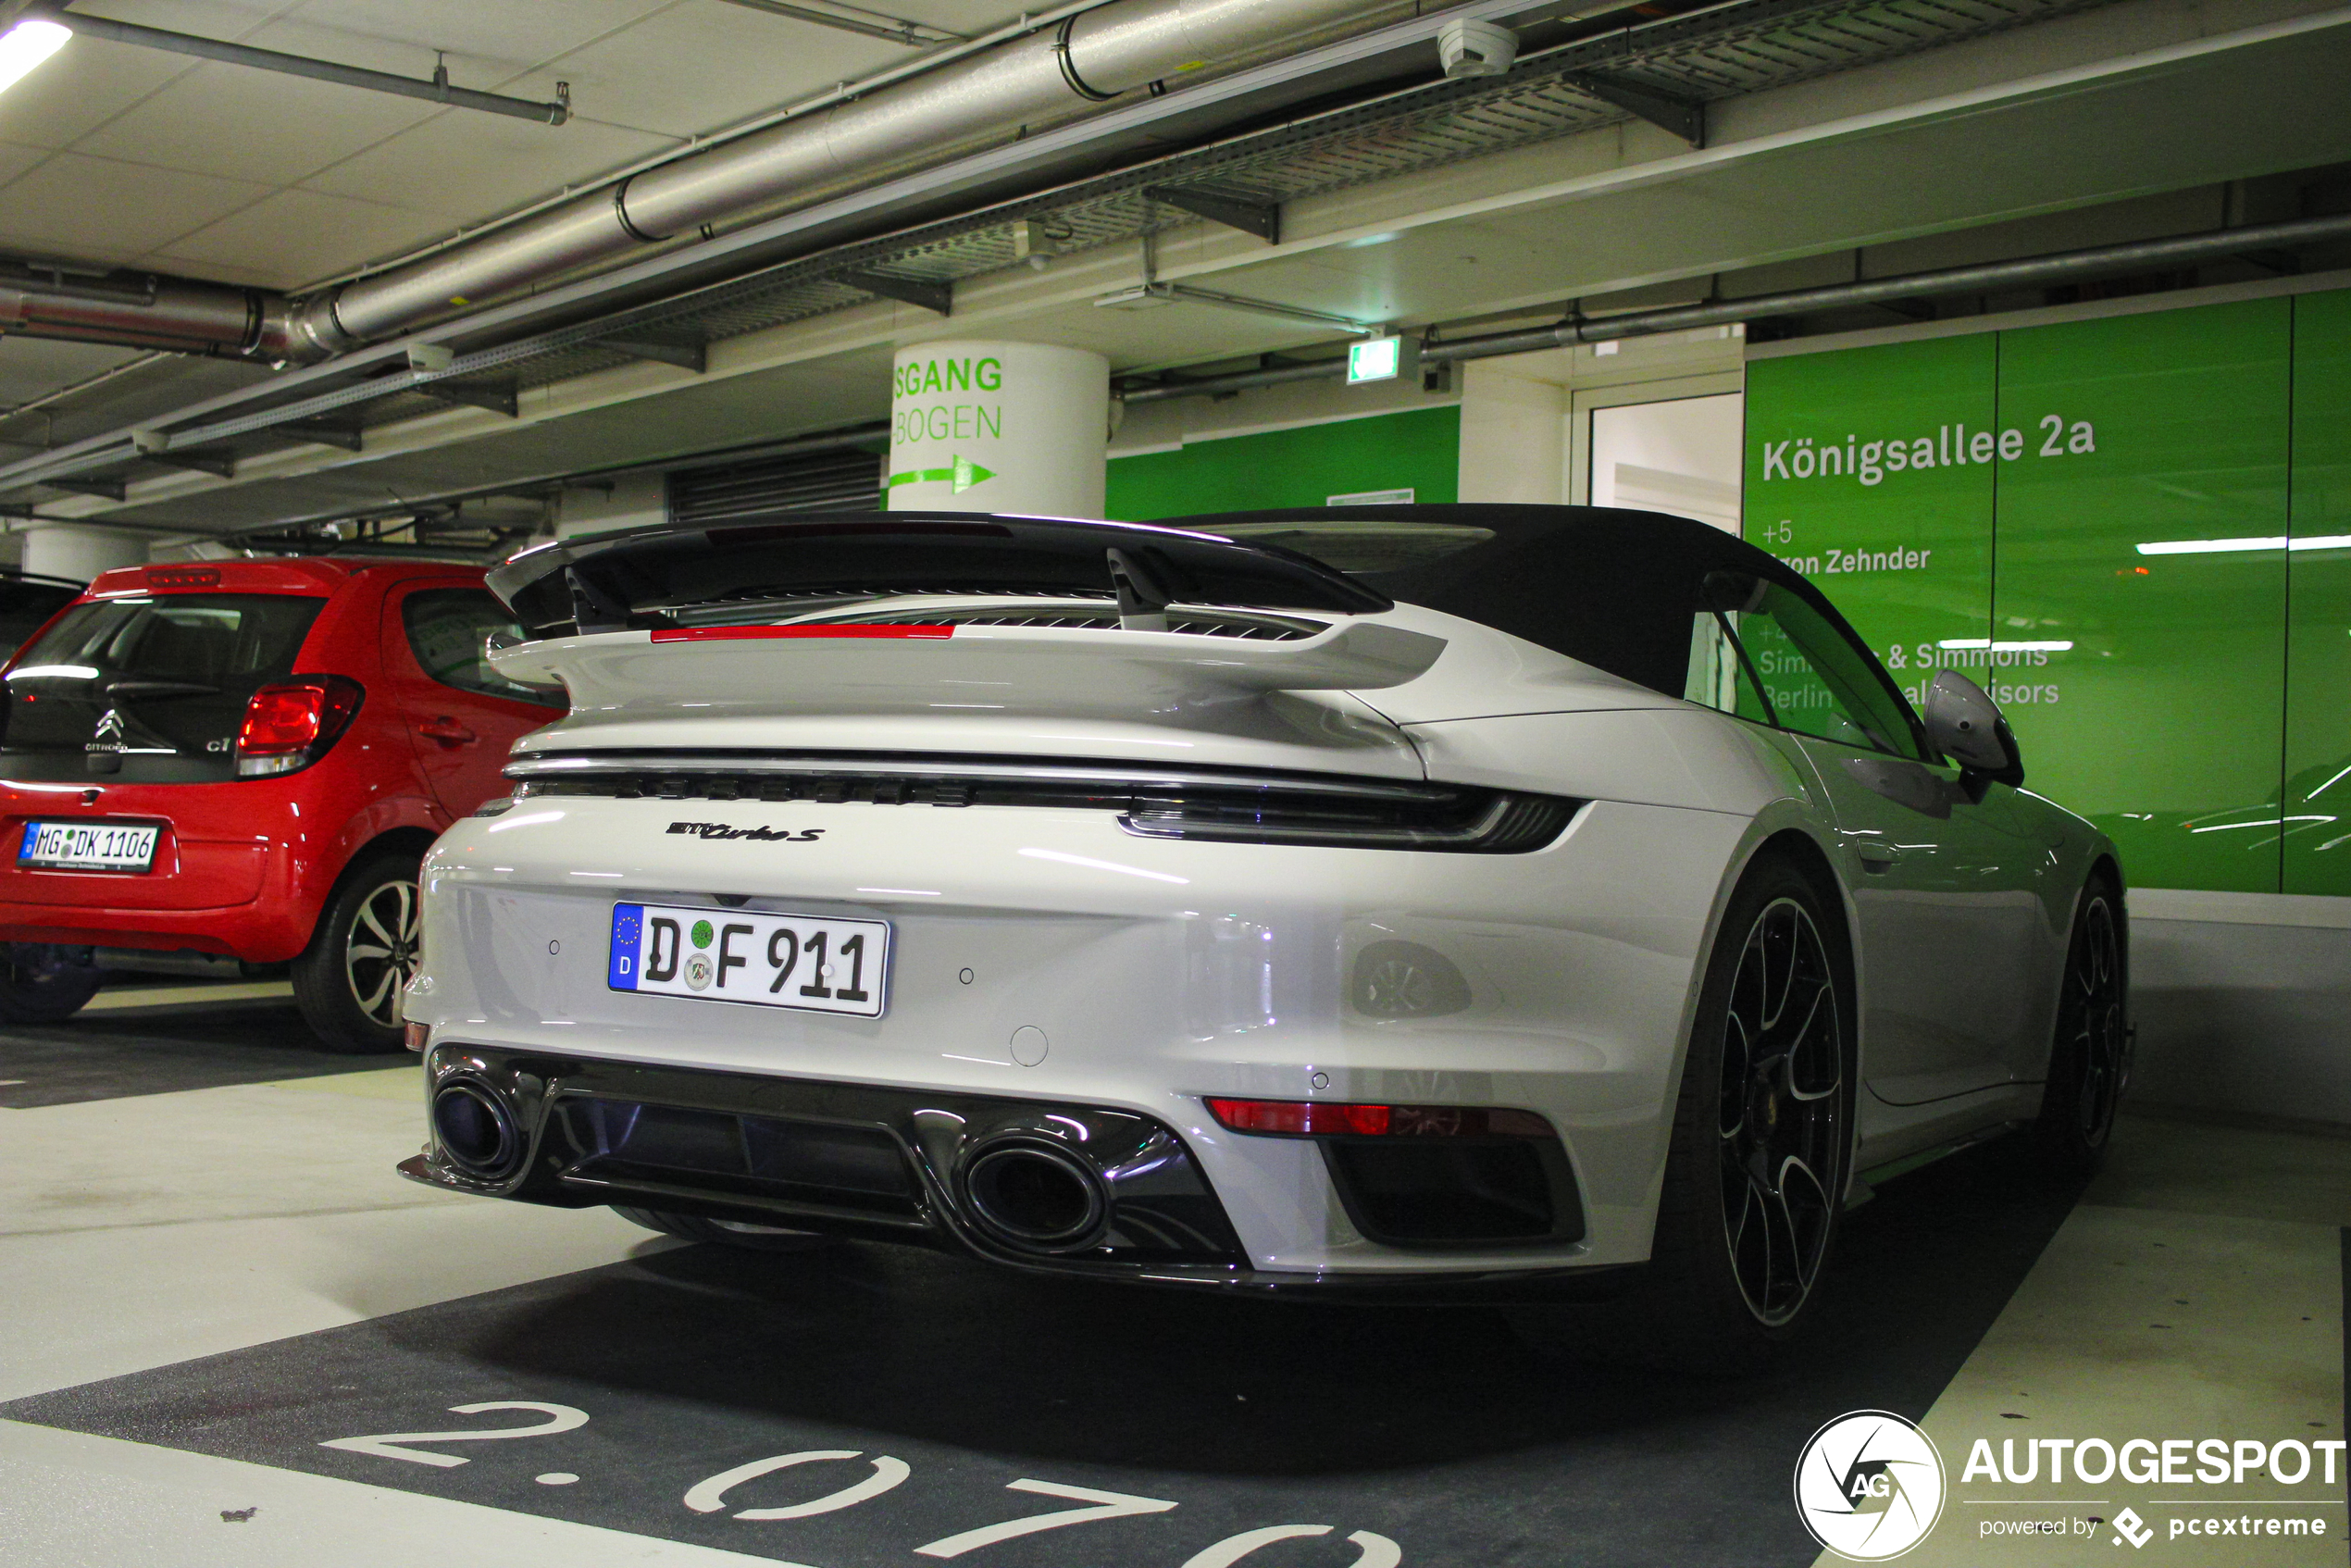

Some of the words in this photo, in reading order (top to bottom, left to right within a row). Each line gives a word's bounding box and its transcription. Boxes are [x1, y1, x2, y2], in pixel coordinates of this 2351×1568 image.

[895, 357, 1001, 399] SGANG
[1763, 423, 2023, 486] Königsallee
[2039, 415, 2096, 457] 2a
[1762, 520, 1792, 543] +5
[1770, 553, 1819, 574] on
[1825, 546, 1931, 574] Zehnder
[1888, 644, 1908, 669] &
[1916, 643, 2047, 668] Simmons
[1763, 684, 1833, 709] Berlin
[1984, 678, 2059, 704] isors
[36, 828, 62, 854] MG
[73, 830, 100, 856] DK
[102, 831, 152, 858] 1106
[700, 824, 790, 840] Turbo
[787, 829, 826, 841] S
[619, 956, 630, 975] D
[645, 916, 681, 981] D
[716, 924, 756, 988] F
[767, 928, 868, 1002] 911
